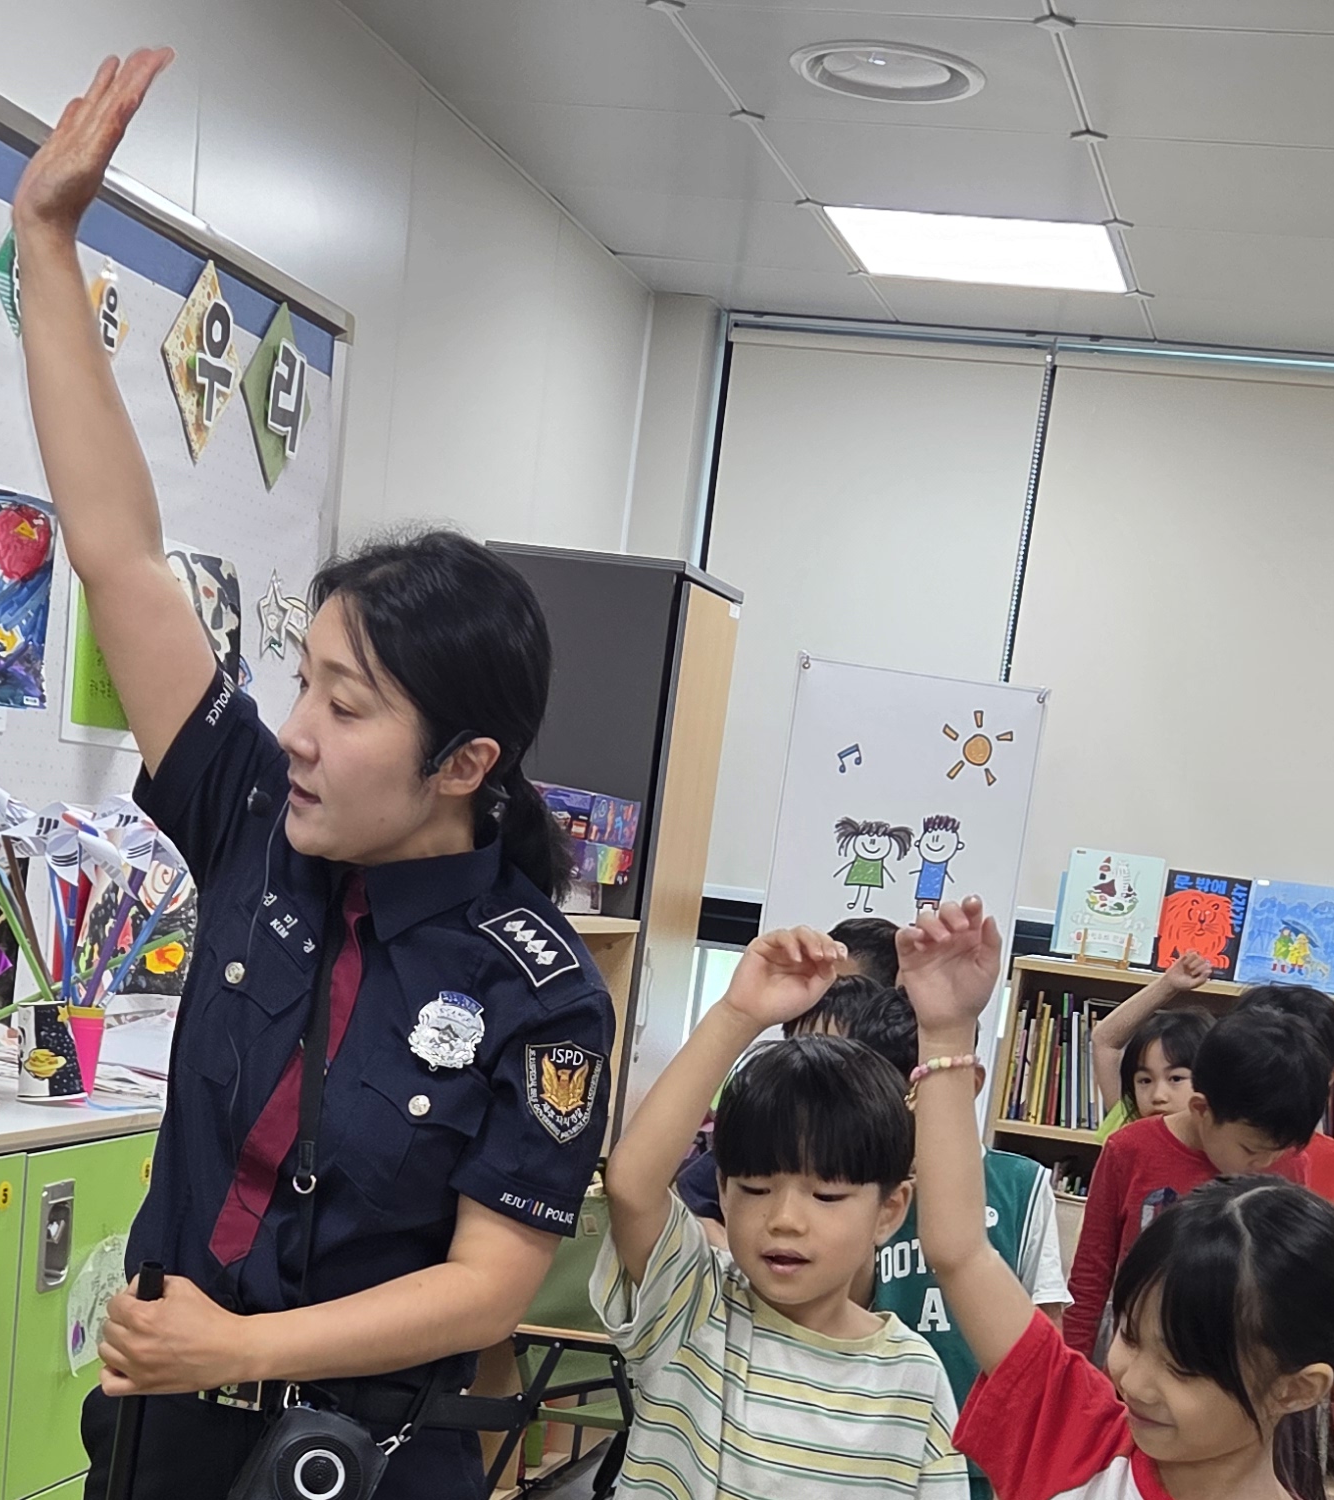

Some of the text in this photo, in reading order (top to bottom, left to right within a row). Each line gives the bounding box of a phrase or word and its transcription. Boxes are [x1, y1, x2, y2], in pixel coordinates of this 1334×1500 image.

[197, 302, 306, 456] 우리
[1174, 874, 1194, 890] 문
[269, 918, 290, 939] KIM
[550, 1047, 584, 1066] JSPD
[1, 1187, 9, 1205] 5
[499, 1191, 575, 1225] JEJU POLICE
[916, 1287, 951, 1333] A
